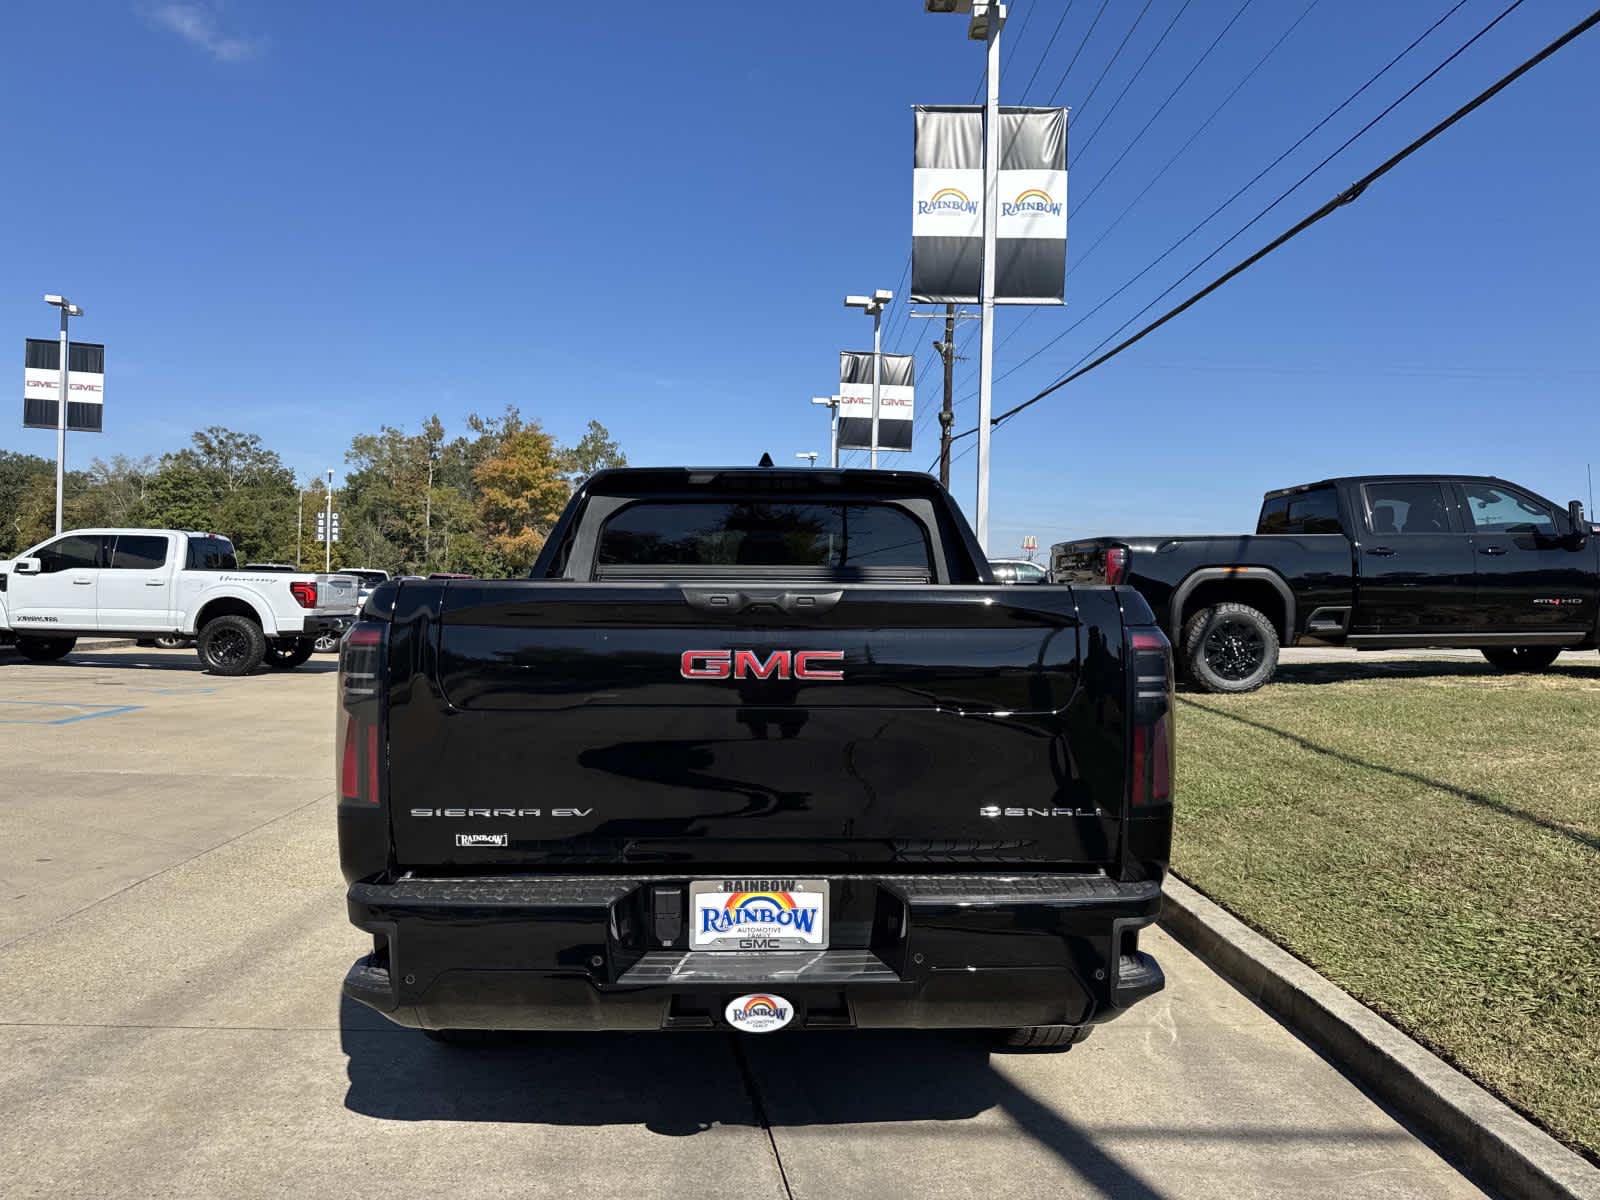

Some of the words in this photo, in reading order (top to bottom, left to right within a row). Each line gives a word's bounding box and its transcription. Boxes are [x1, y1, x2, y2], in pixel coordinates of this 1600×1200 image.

[917, 200, 979, 215] RAINBOW
[1001, 202, 1063, 217] RAINBOW
[27, 380, 60, 389] GMC
[69, 383, 102, 392] GMC
[840, 396, 872, 405] GMC
[881, 398, 912, 407] GMC
[680, 649, 845, 681] GMC
[410, 808, 541, 817] SIERRA
[551, 808, 593, 817] EV
[980, 807, 1102, 817] DENALI
[461, 834, 504, 846] RAINBOW
[723, 880, 796, 892] RAINBOW
[701, 907, 818, 934] RAINBOW
[739, 939, 780, 948] GMC
[733, 1007, 787, 1022] RAINBOW
